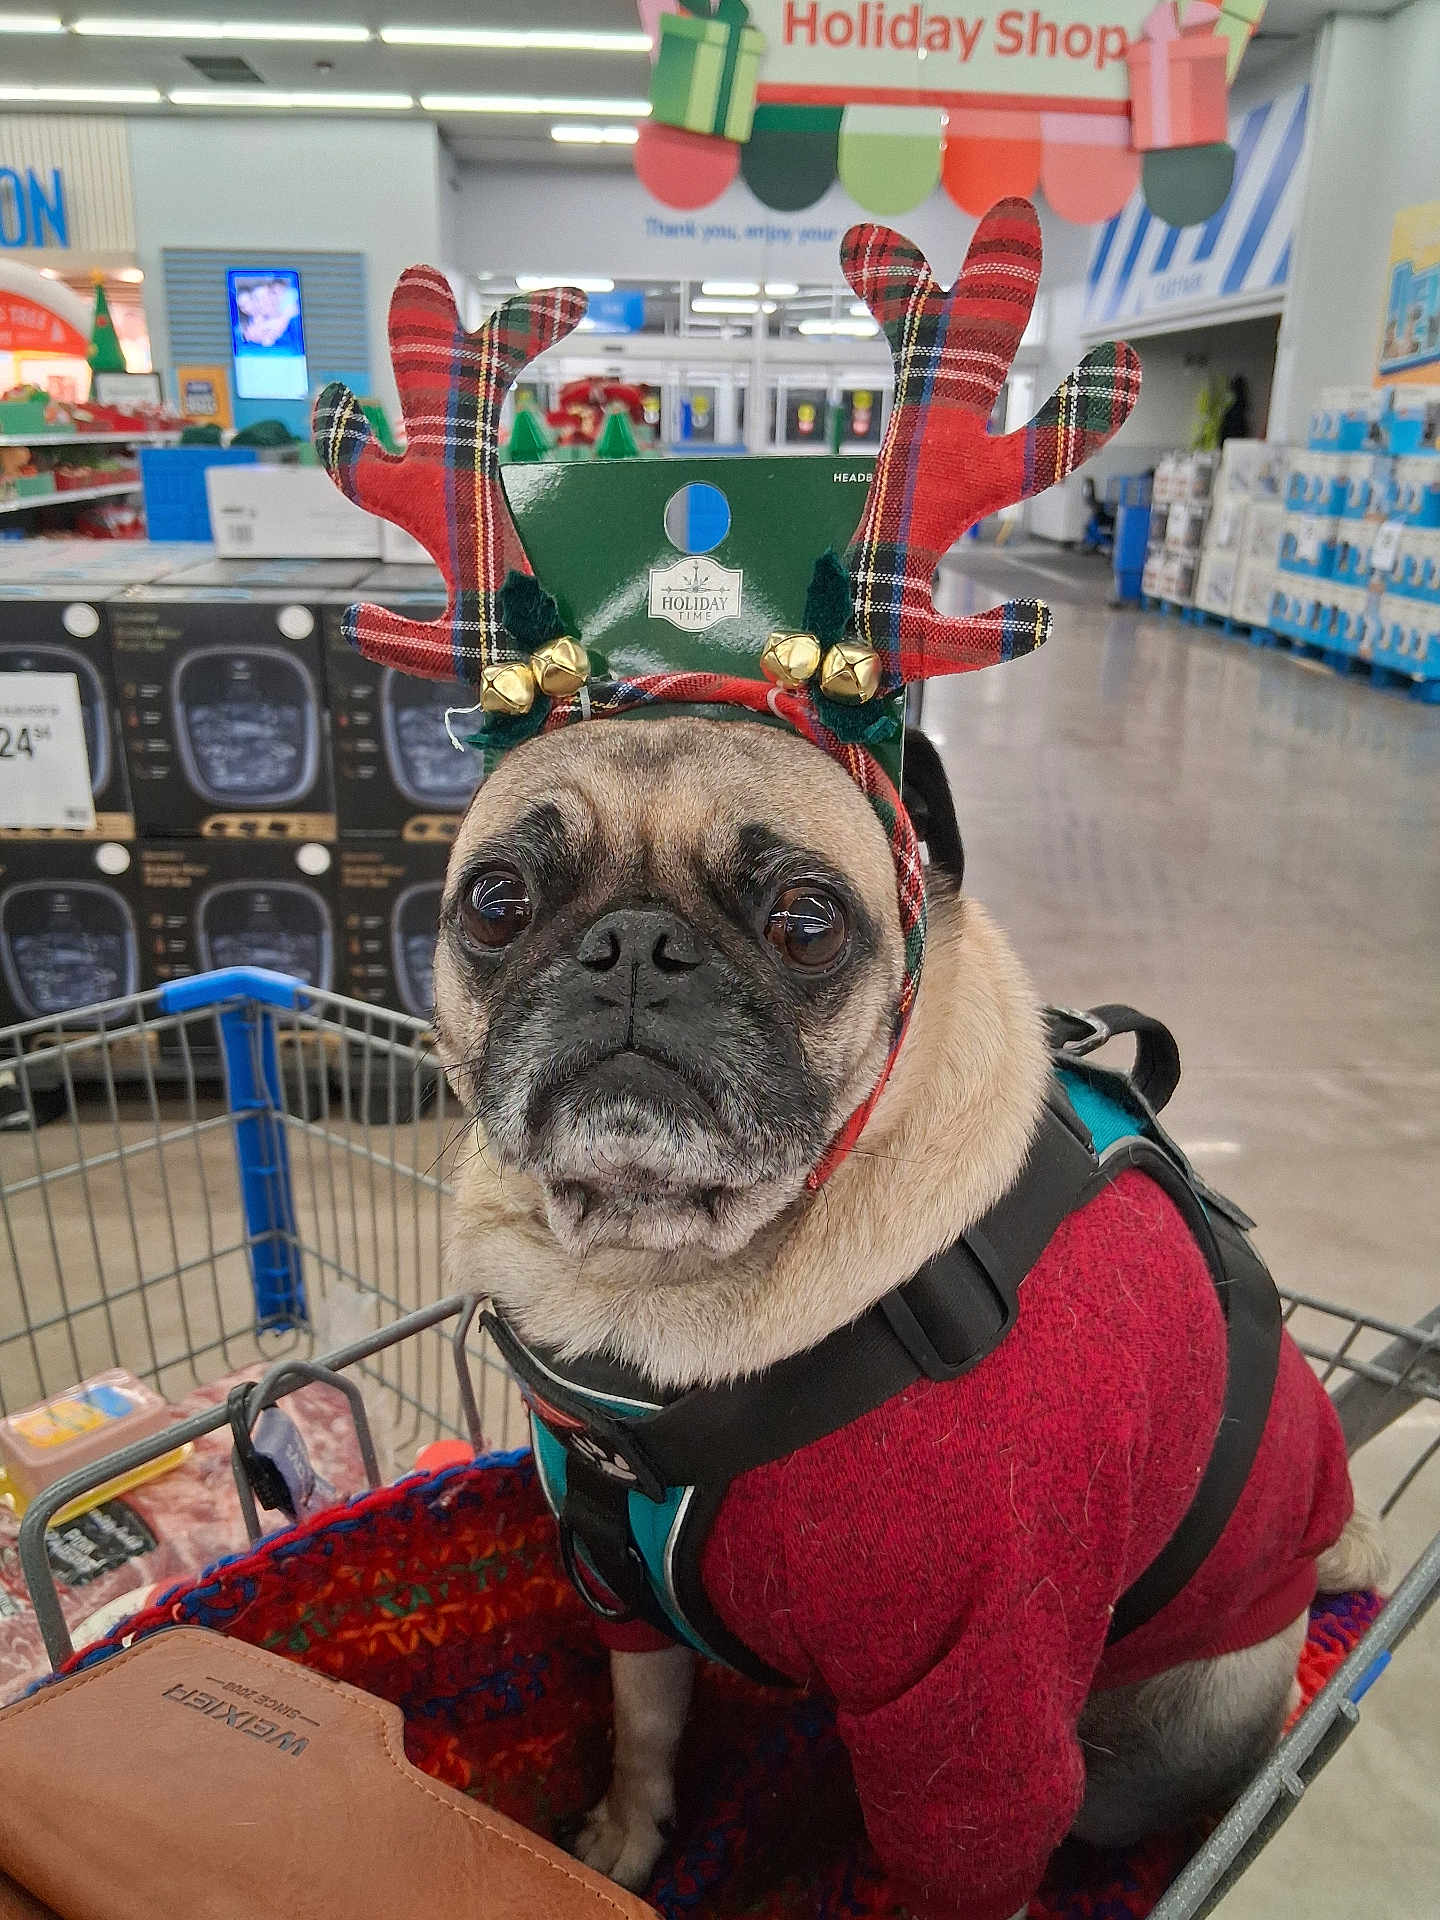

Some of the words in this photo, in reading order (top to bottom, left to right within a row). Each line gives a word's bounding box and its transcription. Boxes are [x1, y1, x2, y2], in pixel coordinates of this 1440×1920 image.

[783, 0, 985, 62] Holiday
[993, 9, 1131, 70] Shop
[0, 167, 69, 248] ON
[645, 216, 696, 238] Thank
[744, 224, 793, 244] enjoy
[661, 596, 728, 611] HOLIDAY
[679, 611, 712, 621] TIME
[161, 1683, 310, 1757] WEIXIER
[254, 1694, 302, 1720] SINCE
